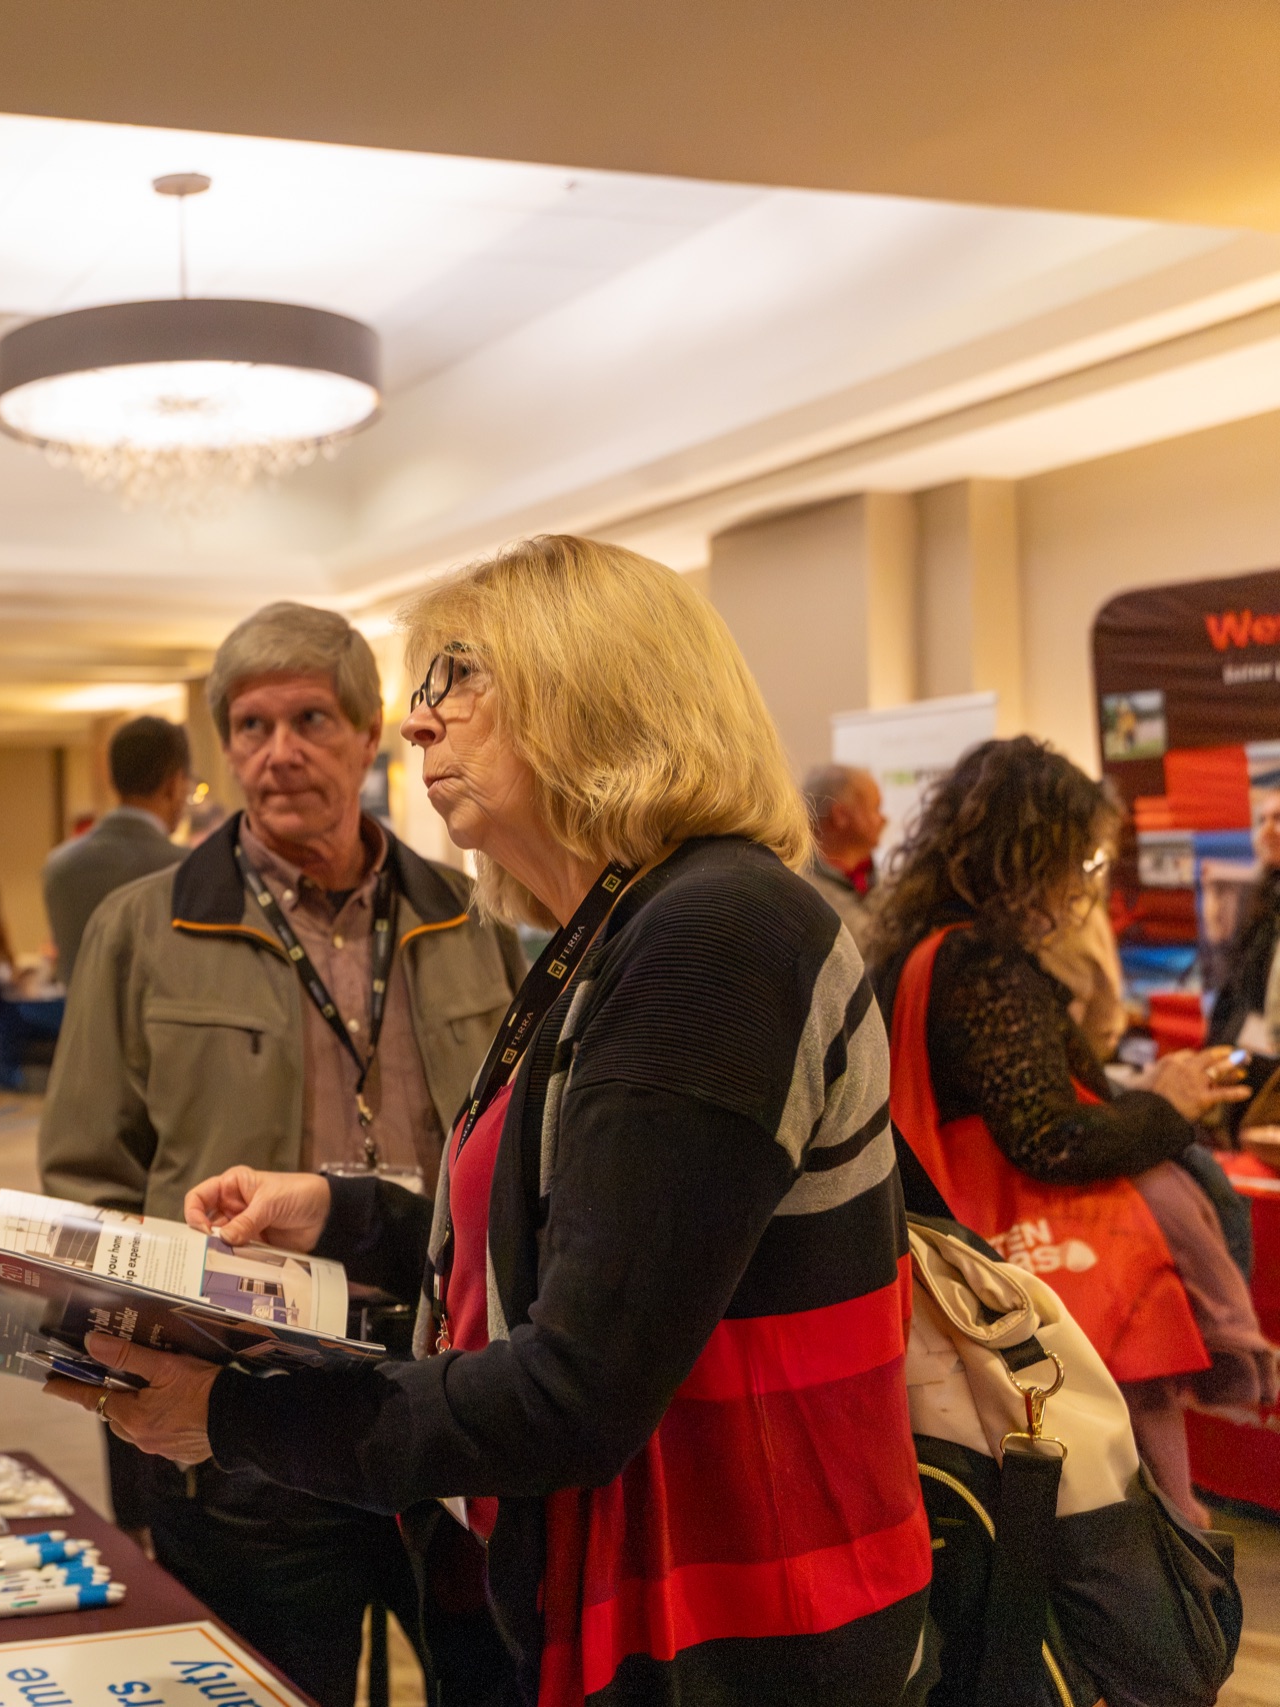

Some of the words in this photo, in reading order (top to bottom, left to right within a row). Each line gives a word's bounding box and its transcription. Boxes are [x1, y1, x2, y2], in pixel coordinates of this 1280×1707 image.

[558, 925, 586, 961] TERRA
[511, 1012, 533, 1046] TERRA
[108, 1235, 123, 1254] home
[107, 1253, 119, 1276] your
[87, 1307, 111, 1327] built
[113, 1307, 139, 1333] builder
